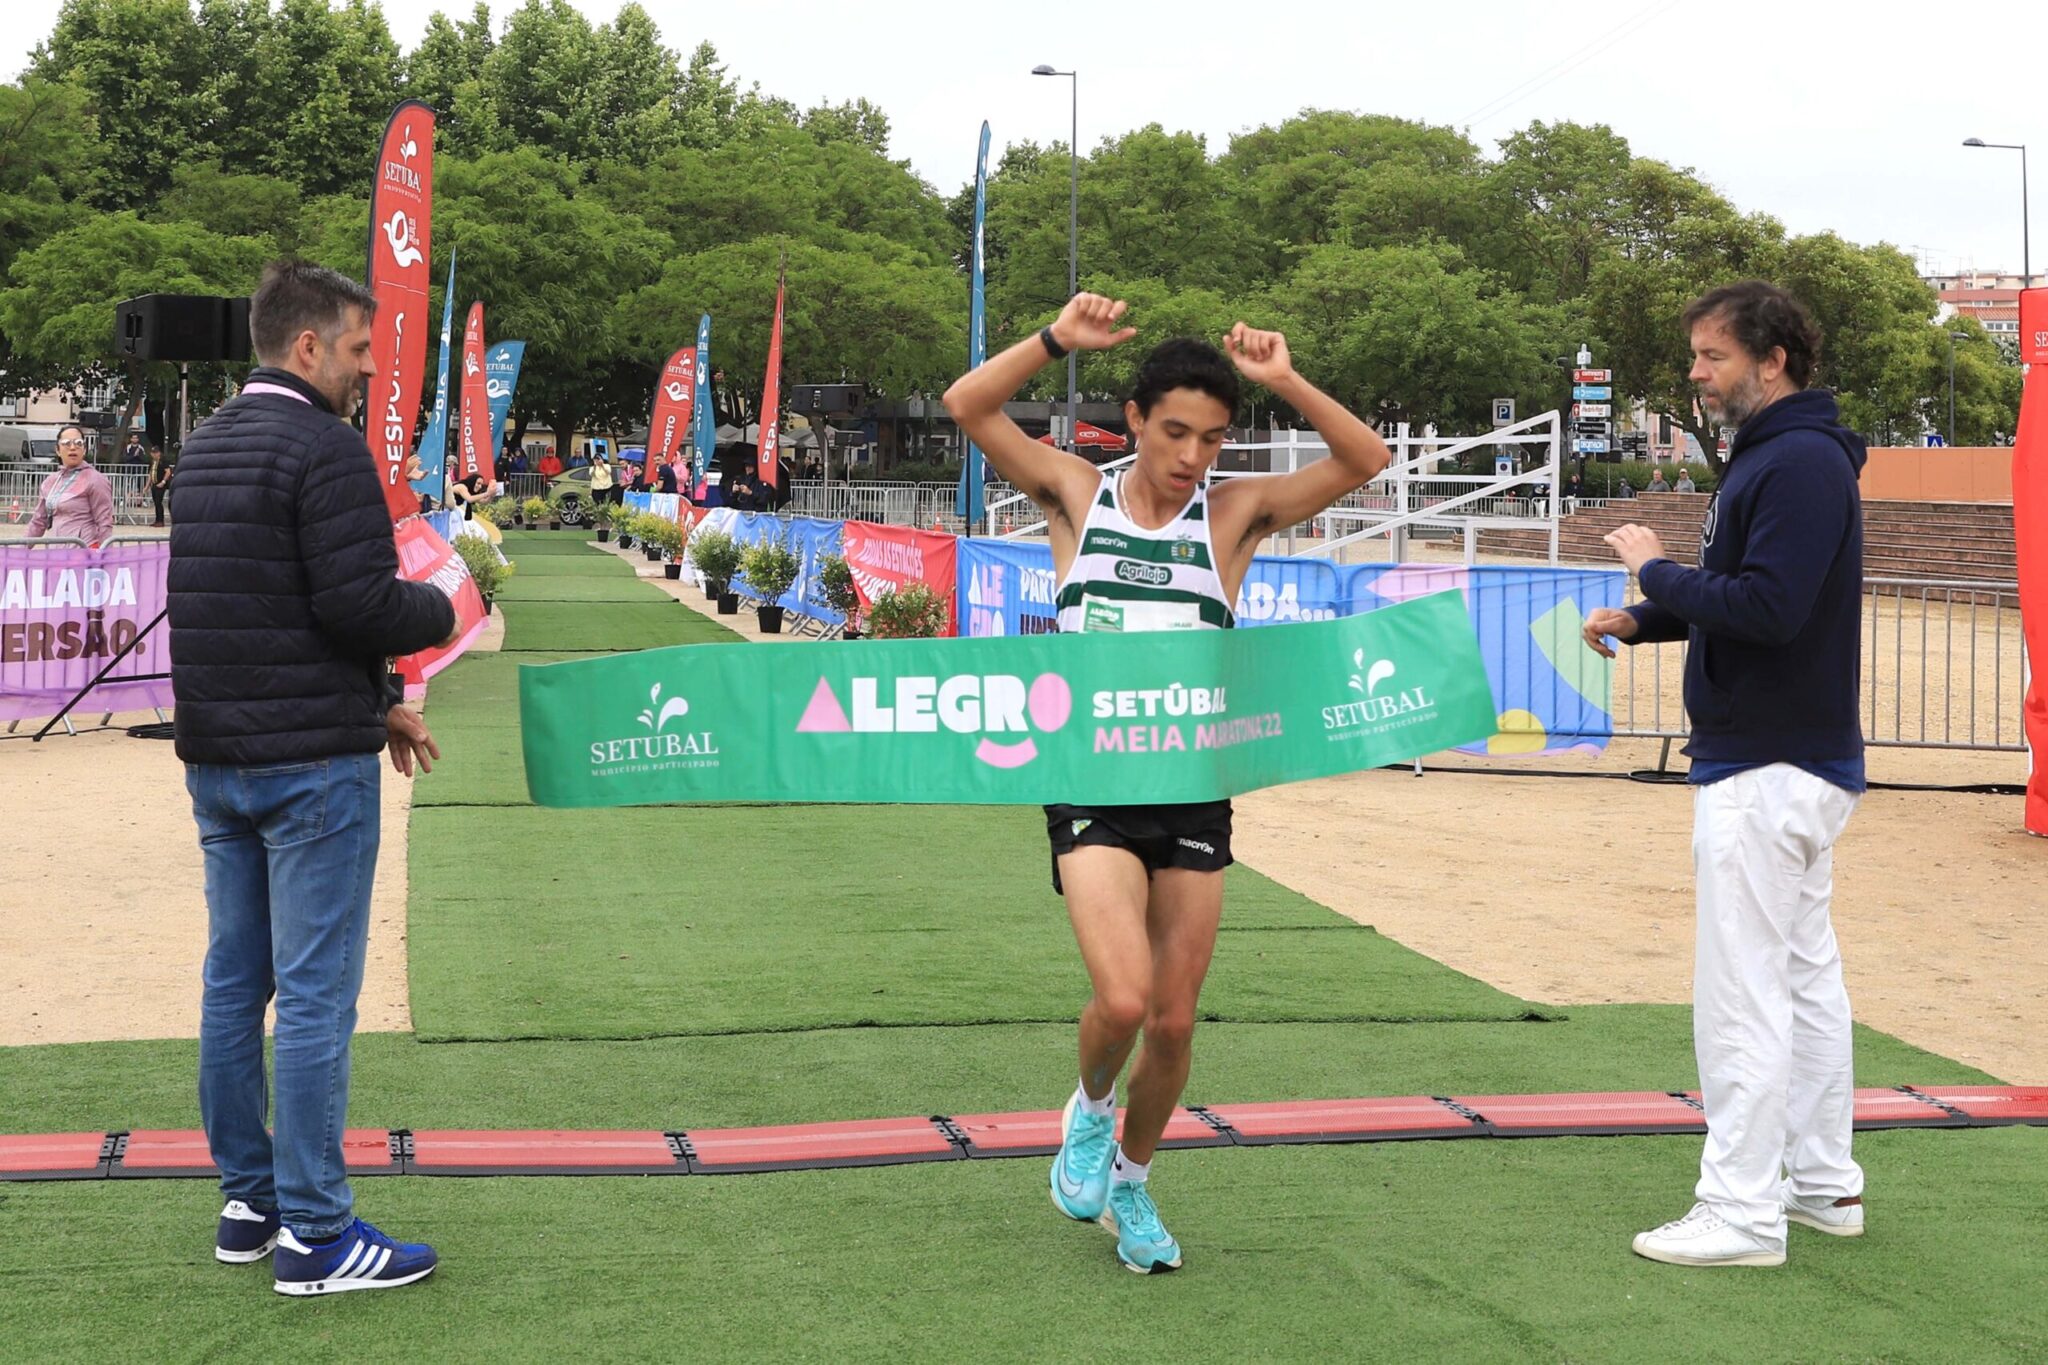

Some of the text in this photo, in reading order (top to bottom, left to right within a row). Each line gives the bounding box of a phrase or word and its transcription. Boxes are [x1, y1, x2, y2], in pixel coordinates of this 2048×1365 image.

[485, 362, 515, 373] ETUBAL
[1118, 562, 1168, 584] Agriloja
[0, 609, 146, 664] ERSÃO.
[795, 672, 1073, 734] ALEGRO
[1093, 682, 1227, 719] SETÚBAL
[1322, 686, 1435, 730] SETUBAL
[590, 732, 719, 765] SETUBAL
[1093, 725, 1186, 754] MEIA
